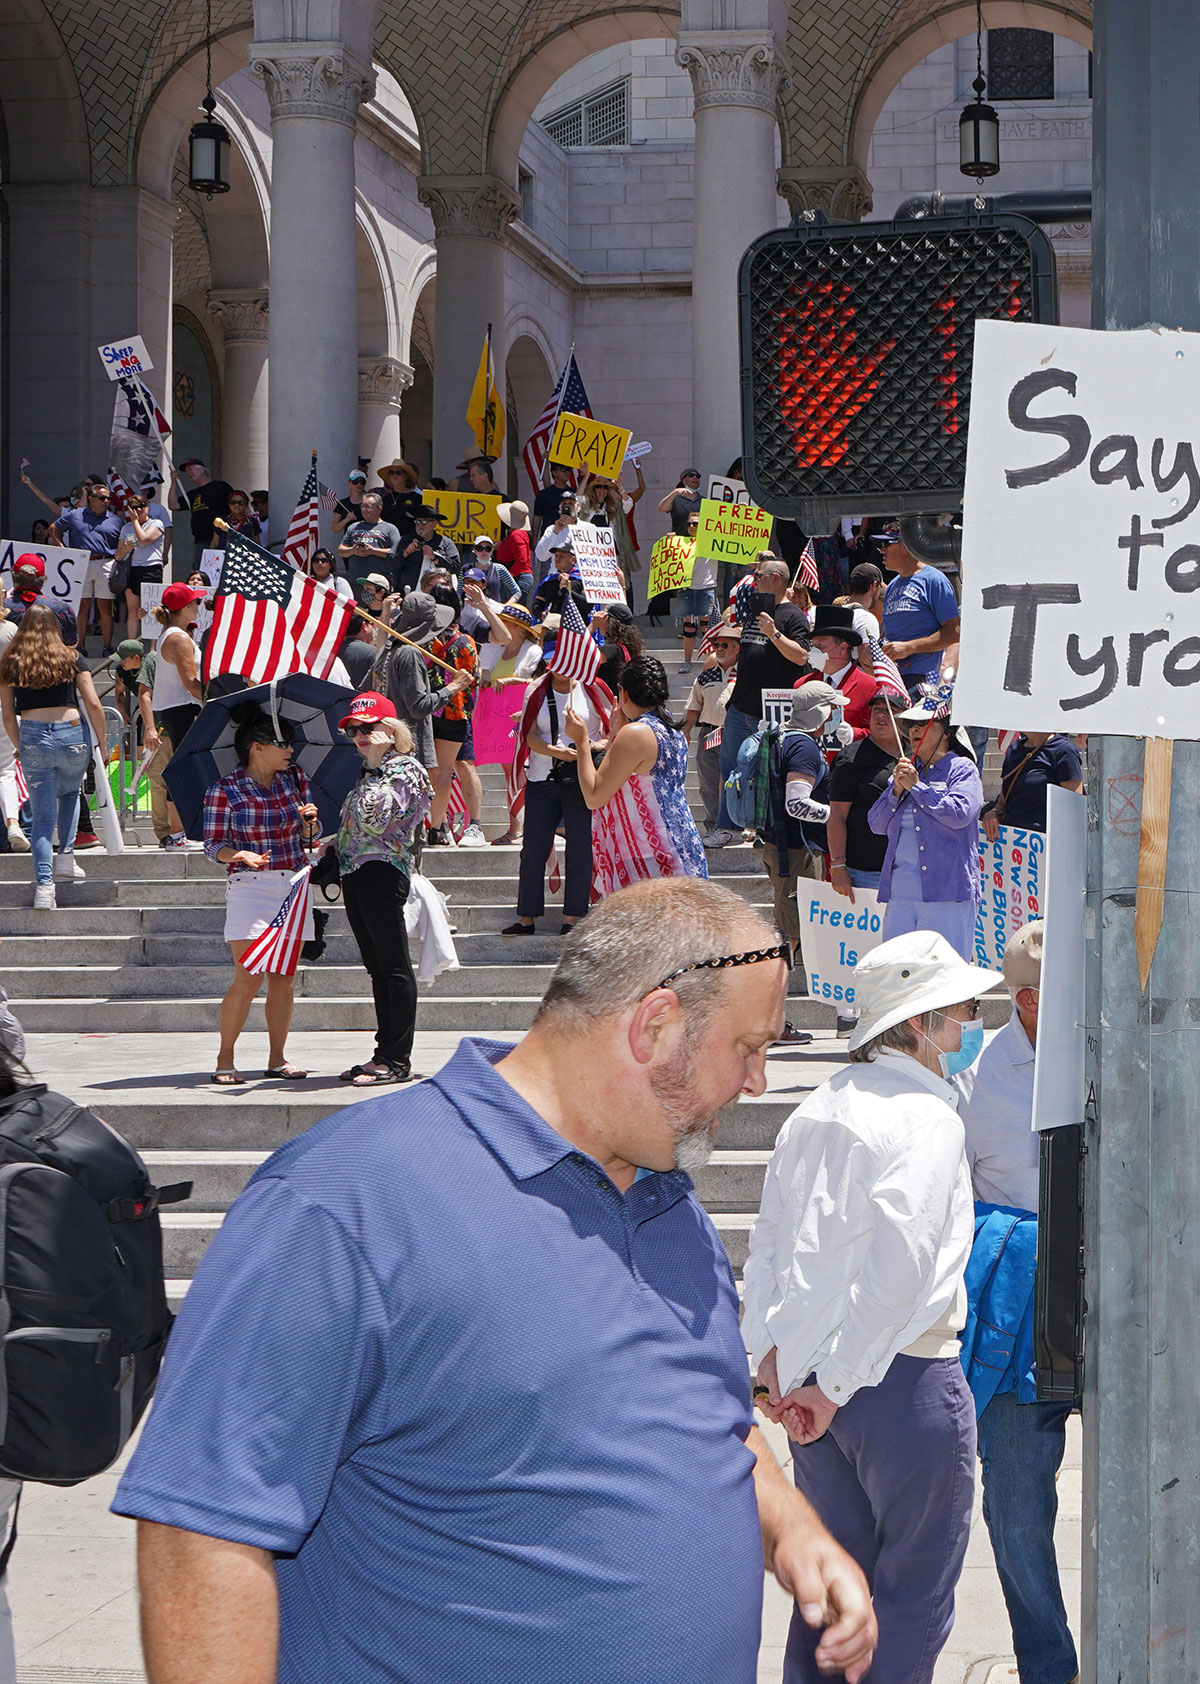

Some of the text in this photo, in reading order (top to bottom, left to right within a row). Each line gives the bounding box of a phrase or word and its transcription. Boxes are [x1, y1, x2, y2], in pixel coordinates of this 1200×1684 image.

[1041, 120, 1085, 137] FAITH
[556, 419, 622, 471] PRAY!
[718, 504, 765, 522] FREE
[571, 529, 612, 545] HELL NO
[704, 518, 770, 539] CALIFORNIA
[575, 545, 615, 558] LOCKDOWN
[657, 536, 696, 552] FULLY
[711, 538, 757, 556] NOW
[579, 557, 617, 570] MSM LIES
[653, 561, 685, 585] LA-CA
[584, 579, 605, 588] POLICE
[656, 575, 685, 593] NOW
[585, 589, 621, 601] TYRANNY
[766, 691, 792, 699] Keeping
[992, 825, 1008, 889] Have
[809, 899, 881, 933] Freedo
[839, 941, 859, 967] Is
